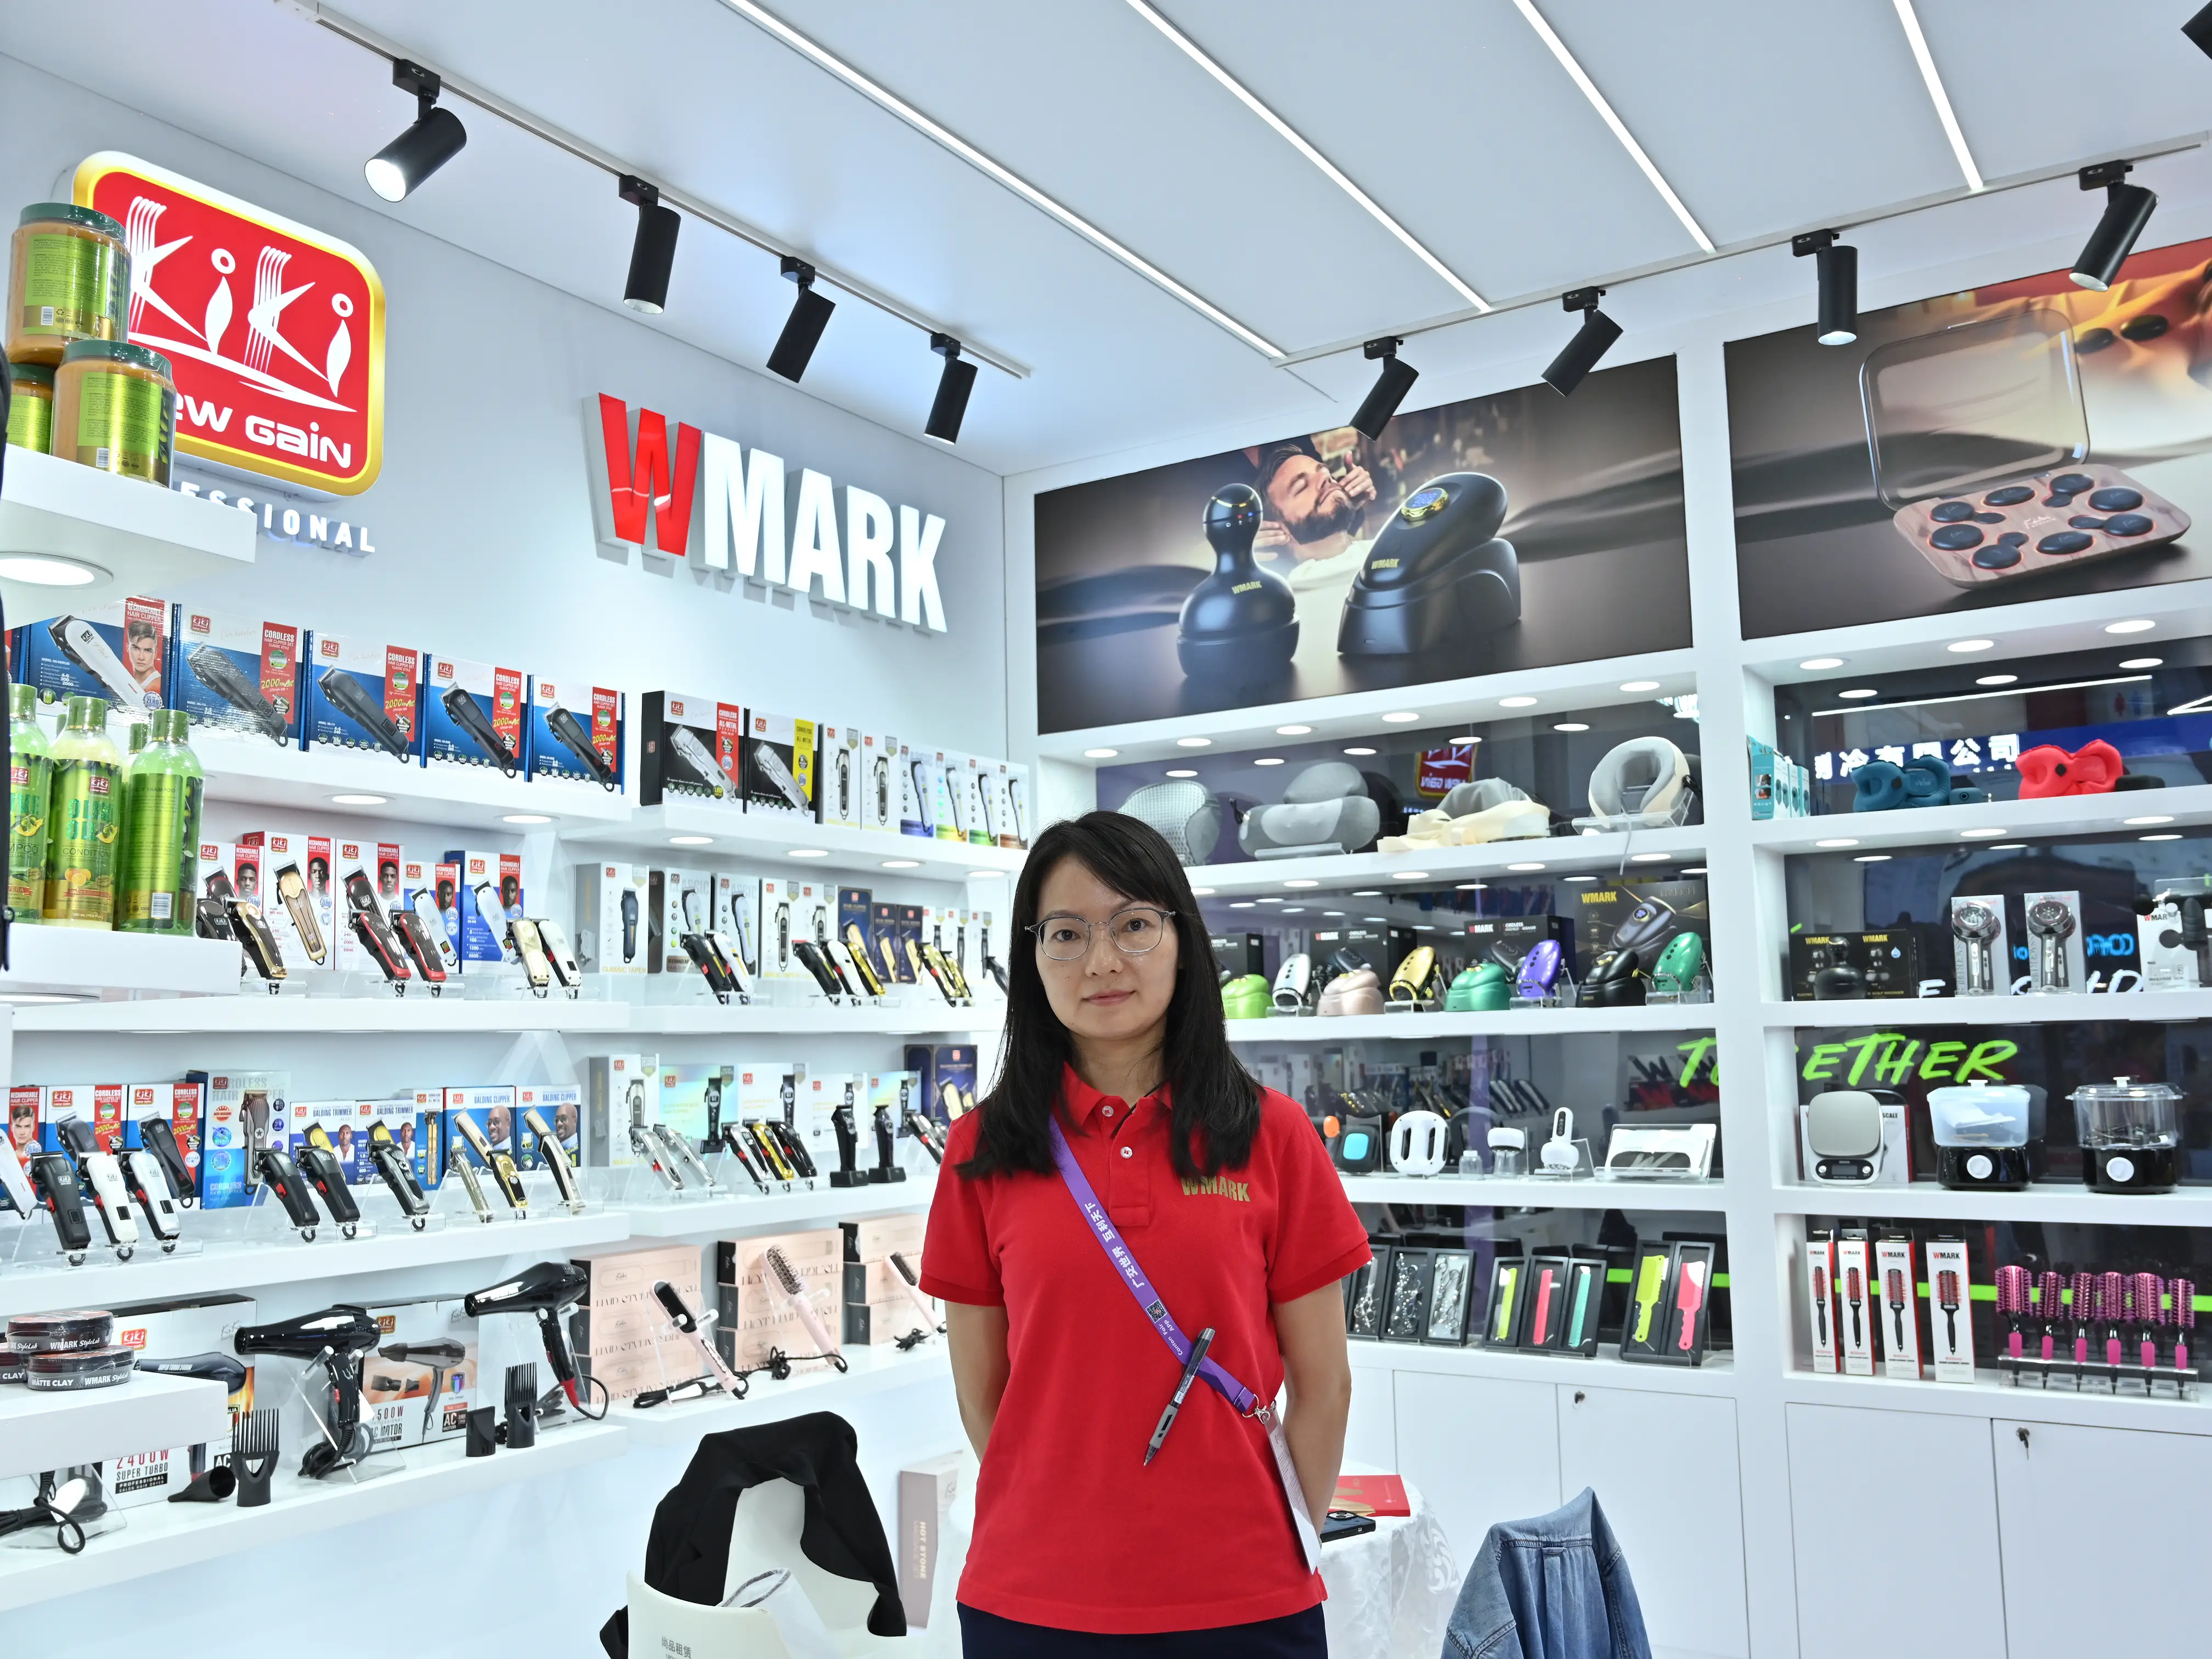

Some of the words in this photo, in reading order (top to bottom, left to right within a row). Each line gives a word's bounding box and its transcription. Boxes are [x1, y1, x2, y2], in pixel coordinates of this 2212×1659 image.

[181, 481, 375, 552] ESSIONAL
[599, 392, 947, 633] WMARK
[1372, 558, 1400, 569] WMARK
[1232, 580, 1262, 594] WMARK
[127, 603, 161, 616] RECHARGEABLE
[127, 610, 140, 618] HAIR
[140, 612, 162, 622] CLIPPER
[264, 629, 295, 642] CORDLESS
[323, 641, 338, 652] KiKi
[388, 652, 415, 665] CORDLESS
[439, 663, 453, 672] KiKi
[496, 674, 520, 685] CORDLESS
[542, 684, 554, 693] KiKi
[593, 693, 616, 704] CORDLESS
[719, 709, 737, 719] CORDLESS
[797, 725, 813, 735] CORDLESS
[91, 778, 108, 788] KiKi
[273, 838, 287, 847] KiKi
[202, 845, 218, 855] KiKi
[344, 845, 358, 854] KiKi
[471, 860, 484, 868] KiKi
[1581, 891, 1617, 904] WMARK
[1469, 924, 1493, 933] WMARK
[1805, 936, 1830, 945] WMARK
[1863, 934, 1888, 943] WMARK
[229, 1077, 267, 1088] RDLESS
[54, 1091, 71, 1101] KiKi
[137, 1090, 153, 1098] KiKi
[212, 1090, 239, 1102] HAIR
[474, 1096, 493, 1104] BALDING
[493, 1095, 510, 1103] CLIPPER
[543, 1093, 560, 1102] BALDING
[561, 1093, 577, 1101] CLIPPER
[332, 1108, 352, 1116] TRIMMER
[395, 1106, 414, 1114] TRIMMER
[210, 1182, 242, 1191] CORDLESS
[1181, 1176, 1250, 1202] WMARK
[1084, 1202, 1115, 1242] 互利天下
[1112, 1246, 1145, 1288] 广交世界
[1159, 1324, 1168, 1335] Fair
[1164, 1319, 1175, 1331] APP
[123, 1331, 144, 1341] KiKi
[17, 1342, 38, 1351] StyleLab
[50, 1340, 78, 1350] WMARK
[79, 1337, 100, 1347] StyleLab
[1168, 1336, 1183, 1356] Canton
[84, 1375, 111, 1385] WMARK
[112, 1372, 129, 1382] StyleLab
[443, 1412, 457, 1426] AC
[380, 1423, 402, 1436] MOTOR
[216, 1454, 231, 1469] AC
[116, 1467, 141, 1481] SUPER
[144, 1462, 168, 1476] TURBO
[119, 1475, 165, 1488] PROFESSIONAL
[662, 1637, 691, 1658] 尚品租赁
